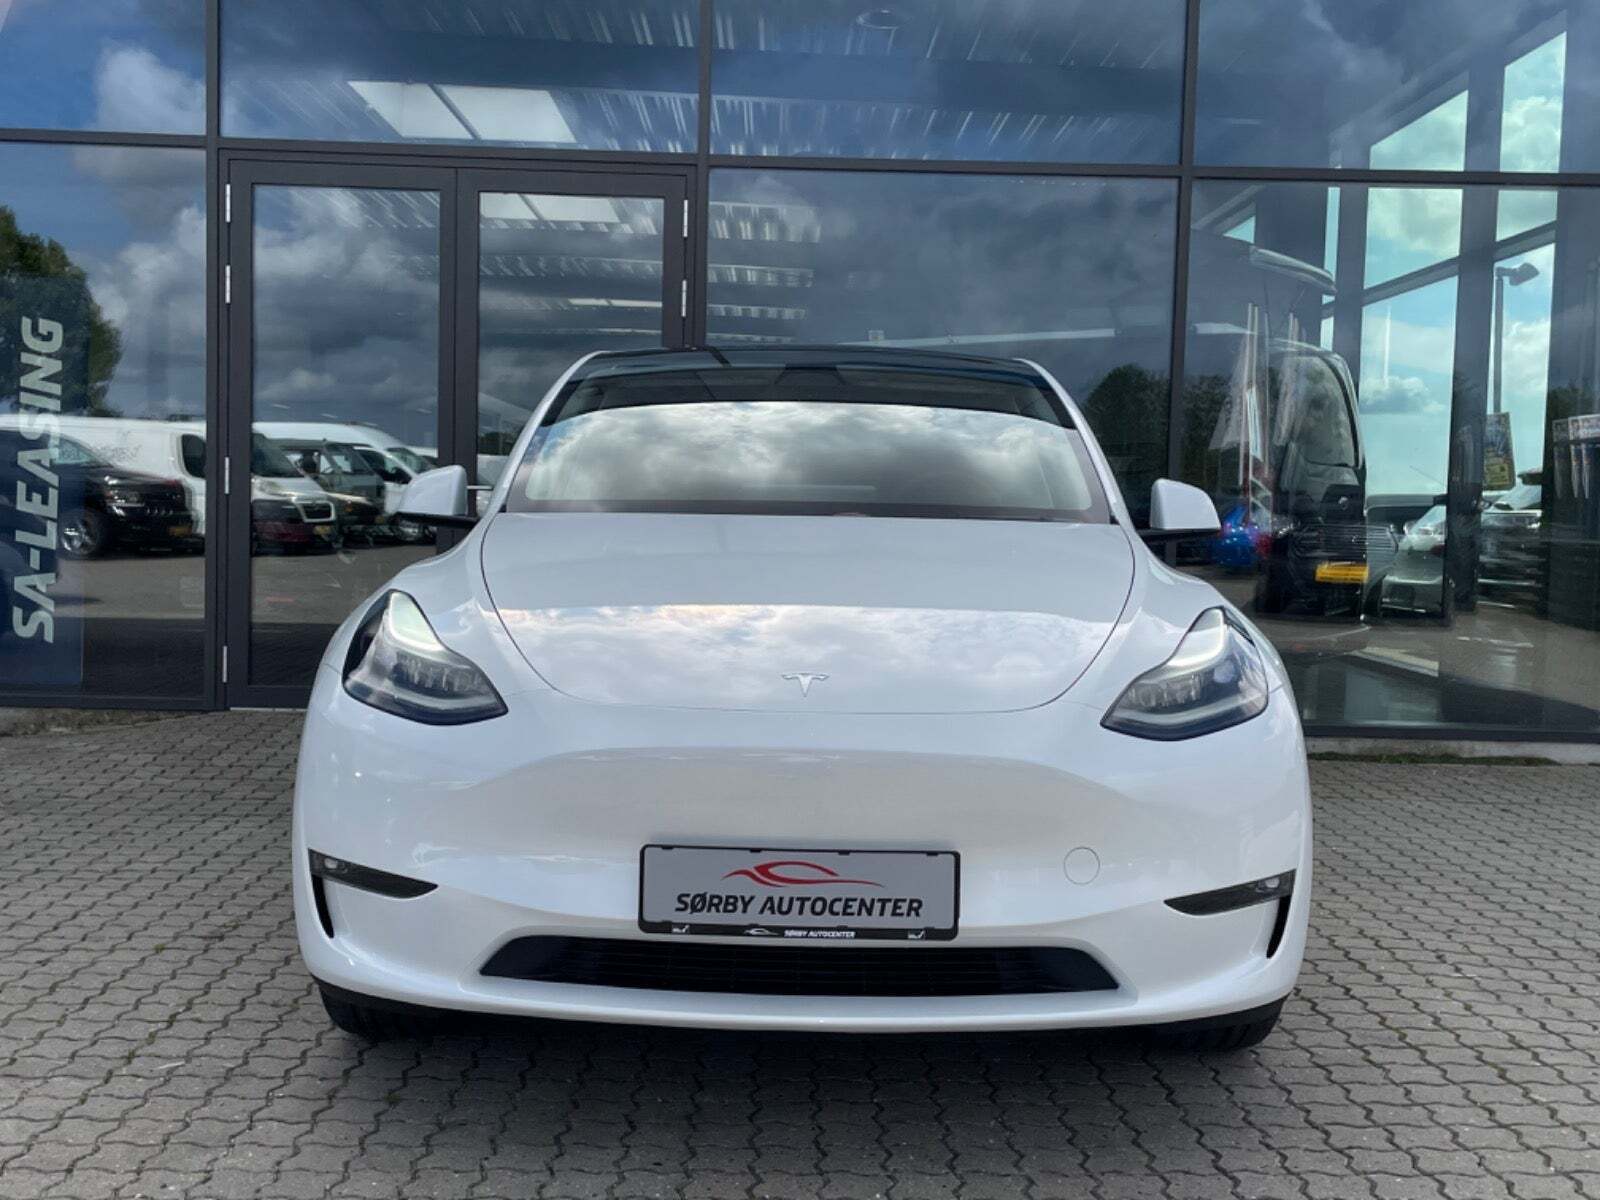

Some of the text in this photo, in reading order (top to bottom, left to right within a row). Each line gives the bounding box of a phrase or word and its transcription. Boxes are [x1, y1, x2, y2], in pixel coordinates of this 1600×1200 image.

[12, 316, 64, 643] SA-LEASING
[674, 891, 923, 918] SØRBY AUTOCENTER
[807, 930, 856, 939] AUTOCENTER
